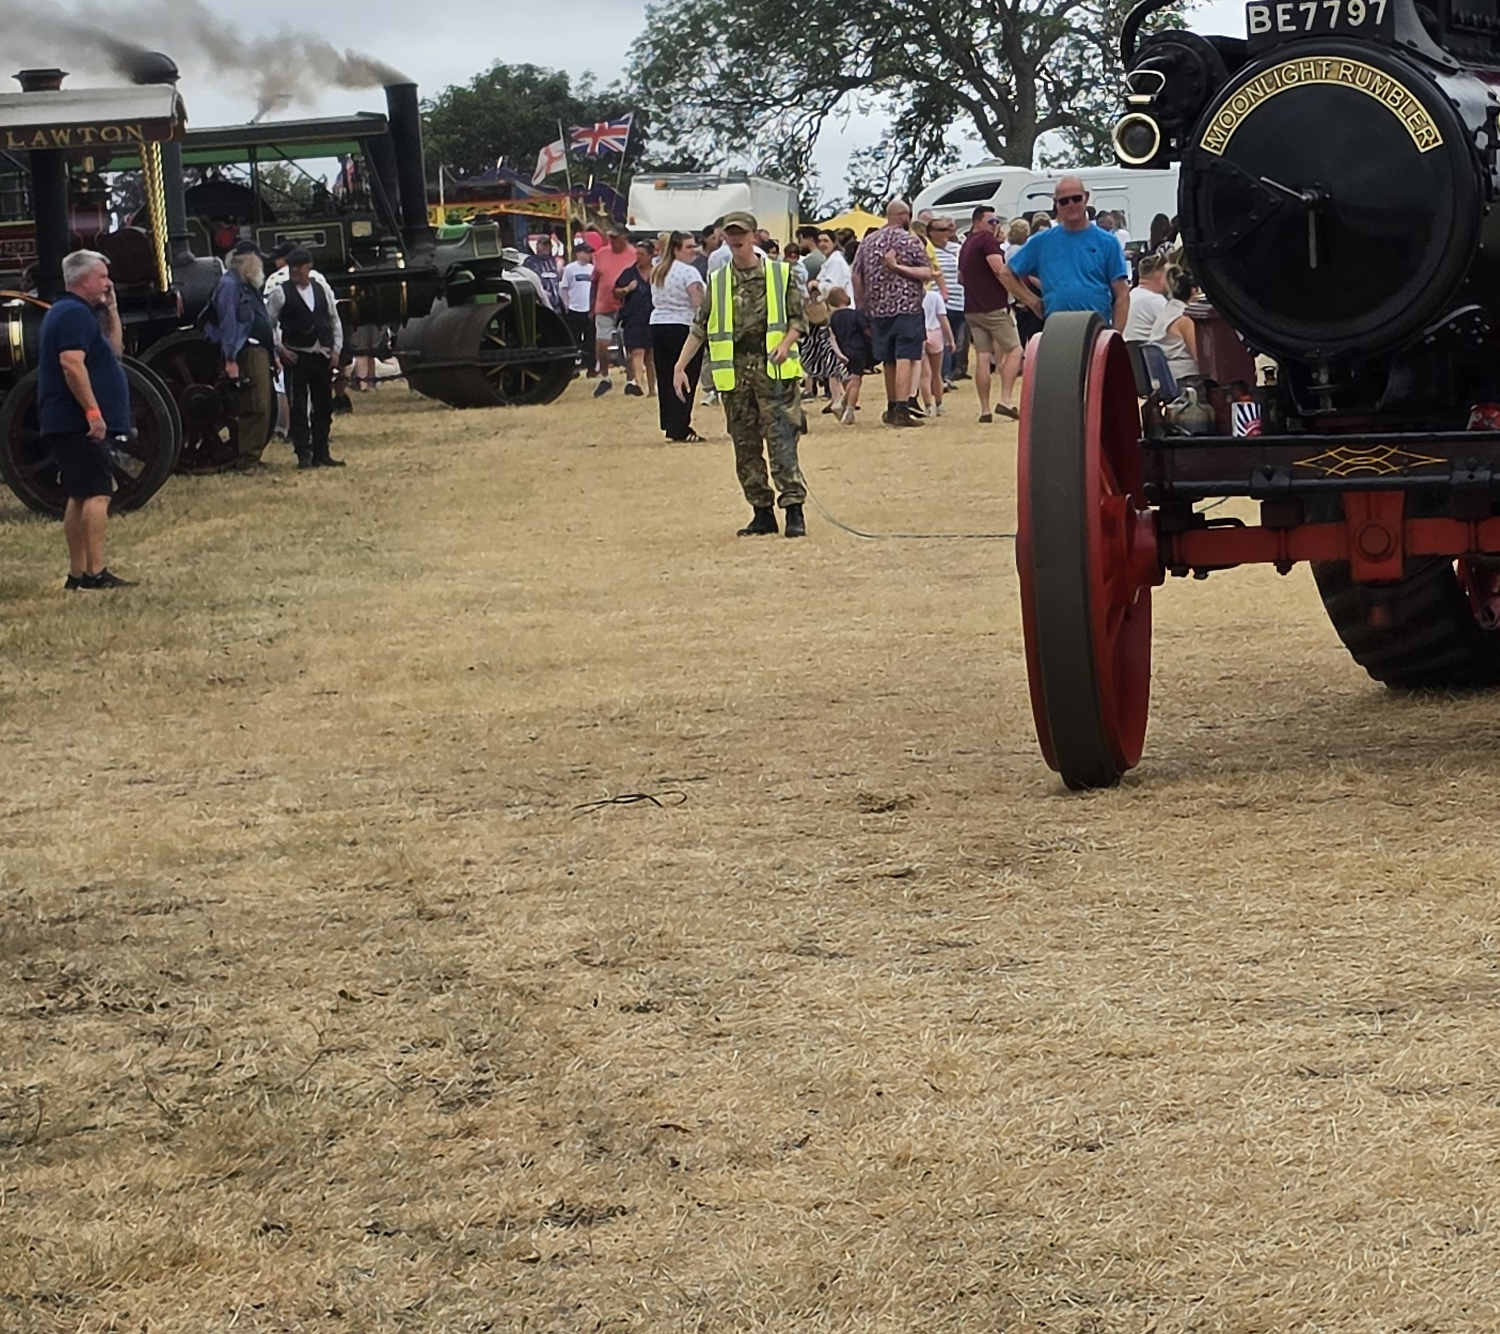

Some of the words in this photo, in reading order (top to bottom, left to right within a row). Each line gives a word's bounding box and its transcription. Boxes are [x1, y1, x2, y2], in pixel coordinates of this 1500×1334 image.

[1206, 61, 1332, 149] MOONLIGHT
[1338, 62, 1436, 147] RUMBLER
[6, 124, 144, 150] LAWTON
